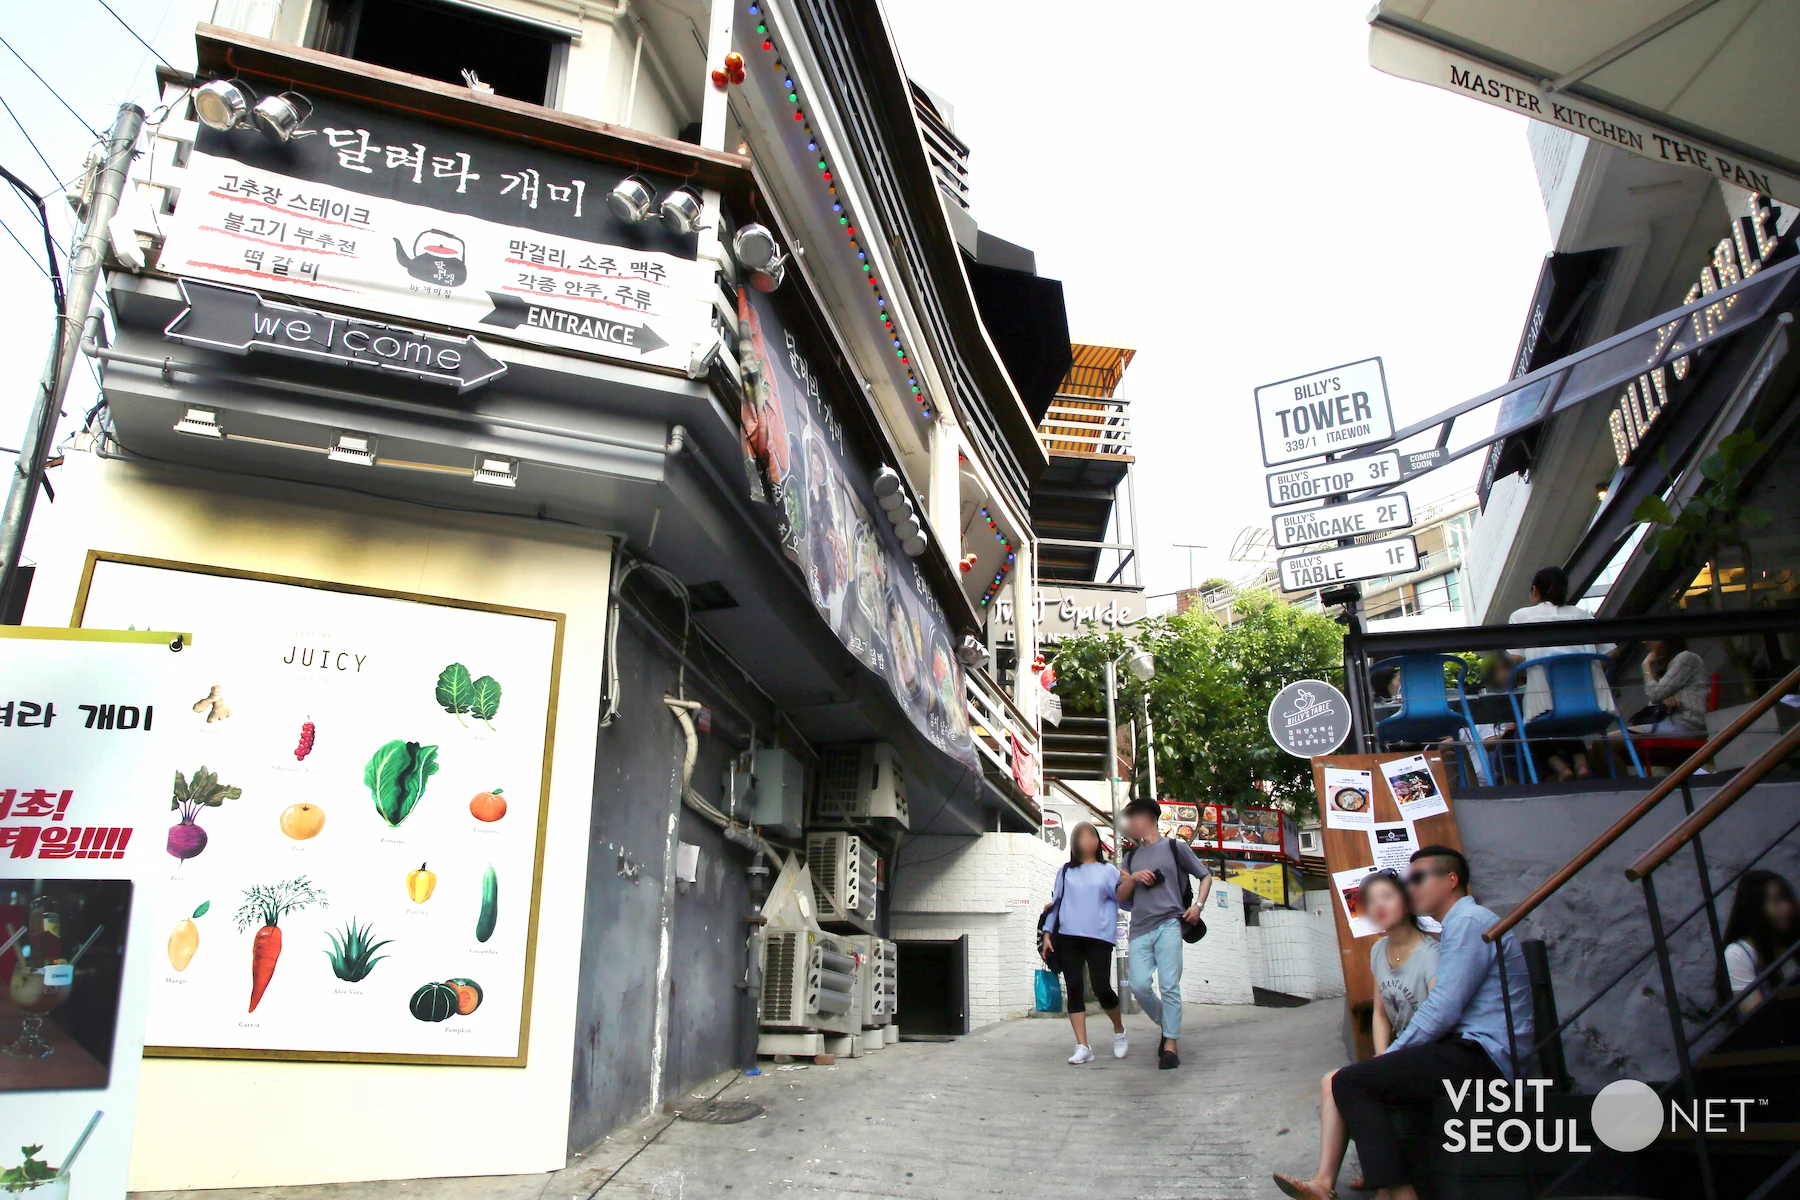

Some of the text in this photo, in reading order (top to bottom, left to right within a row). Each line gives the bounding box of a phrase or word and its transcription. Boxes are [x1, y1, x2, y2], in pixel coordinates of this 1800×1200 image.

[1450, 65, 1773, 196] MASTER KITCHEN THE PAN
[323, 127, 586, 217] 달려라 개미
[217, 174, 370, 225] 고추장 스테이크
[223, 212, 357, 255] 불고기 부추전
[509, 240, 666, 282] 막걸리, 소주, 맥주
[517, 273, 652, 310] 각종 안주, 주류
[254, 312, 462, 370] welcome
[527, 306, 635, 346] ENTRANCE
[784, 328, 843, 457] 달려라 개미
[1294, 377, 1341, 401] BILLY'S
[1275, 391, 1372, 439] TOWER
[1285, 424, 1371, 453] 339/1 ITAEWON
[1409, 450, 1440, 463] COMING
[1277, 471, 1309, 485] BILLY'S
[1278, 461, 1390, 501] ROOFTOP 3F
[1411, 459, 1433, 470] SOON
[1283, 513, 1316, 527] BILLY'S
[1284, 504, 1398, 543] PANCAKE 2F
[1290, 556, 1322, 570] BILLY'S
[1291, 546, 1405, 587] TABLE 1F
[283, 646, 367, 673] JUICY
[78, 703, 154, 732] 개미
[1287, 702, 1330, 725] BILLY'S TABLE
[164, 977, 187, 985] Mango
[445, 1026, 471, 1034] Pumpkin
